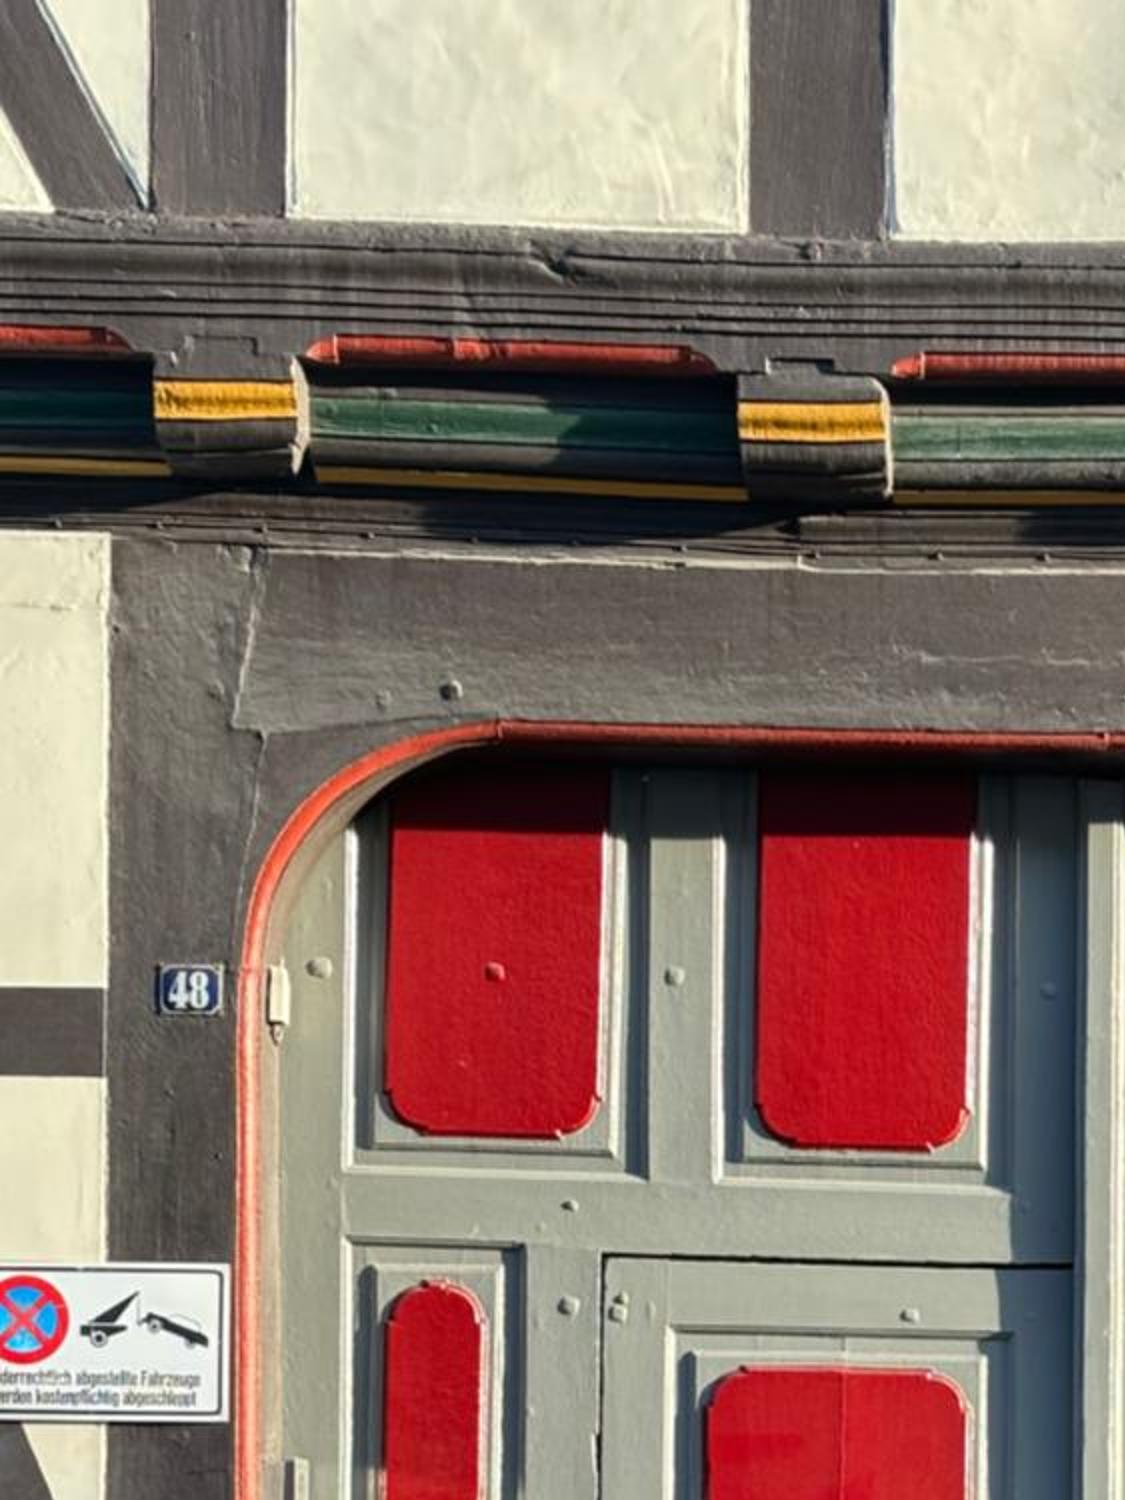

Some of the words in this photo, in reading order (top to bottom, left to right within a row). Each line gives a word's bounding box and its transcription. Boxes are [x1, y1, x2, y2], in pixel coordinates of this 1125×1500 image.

[168, 970, 210, 1009] 48
[0, 1367, 72, 1386] derrechtlich
[0, 1389, 32, 1403] erden
